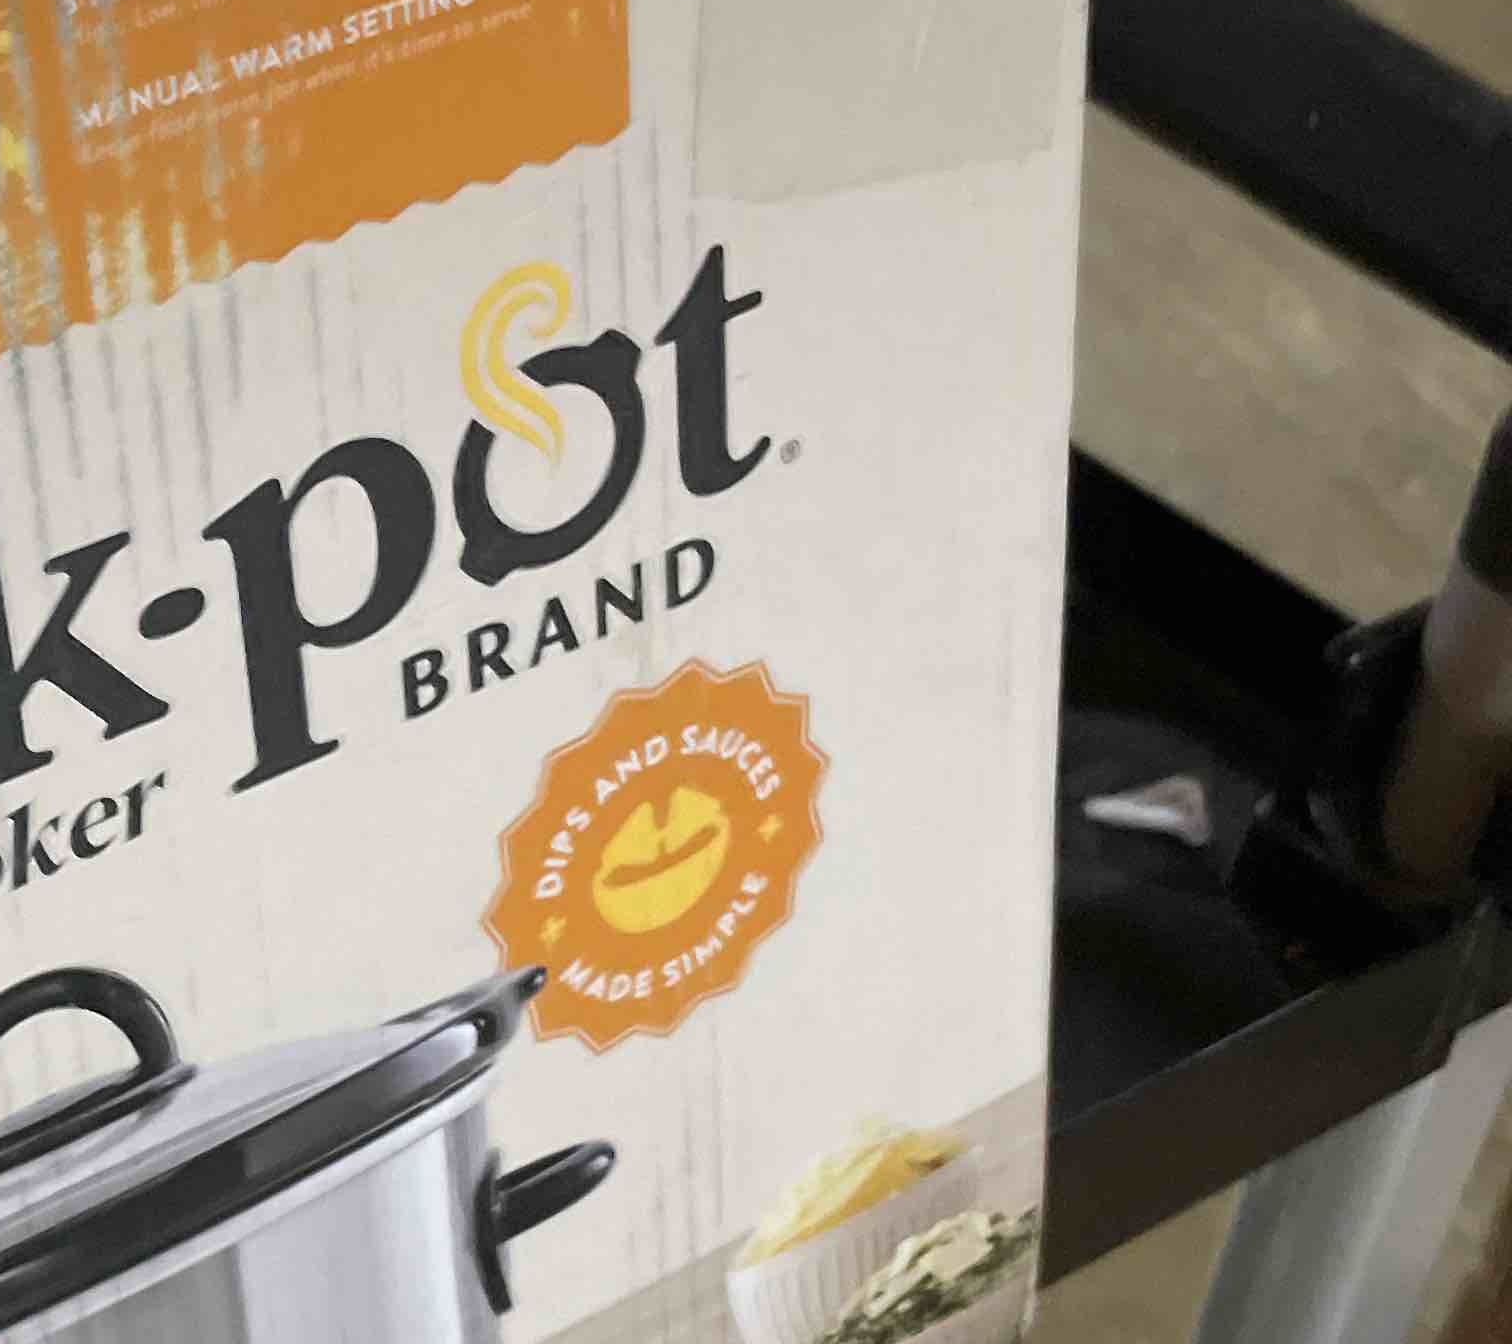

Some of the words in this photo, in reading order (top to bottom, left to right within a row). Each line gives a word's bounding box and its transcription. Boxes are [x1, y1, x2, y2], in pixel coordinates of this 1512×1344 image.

[78, 62, 226, 130] MANUAL
[230, 25, 334, 81] WARM
[400, 537, 716, 701] BRAND
[534, 805, 592, 900] DIPS
[595, 735, 669, 806] AND
[680, 723, 782, 801] SAUCES
[559, 957, 655, 1003] MADE
[662, 871, 769, 987] SIMPLE
